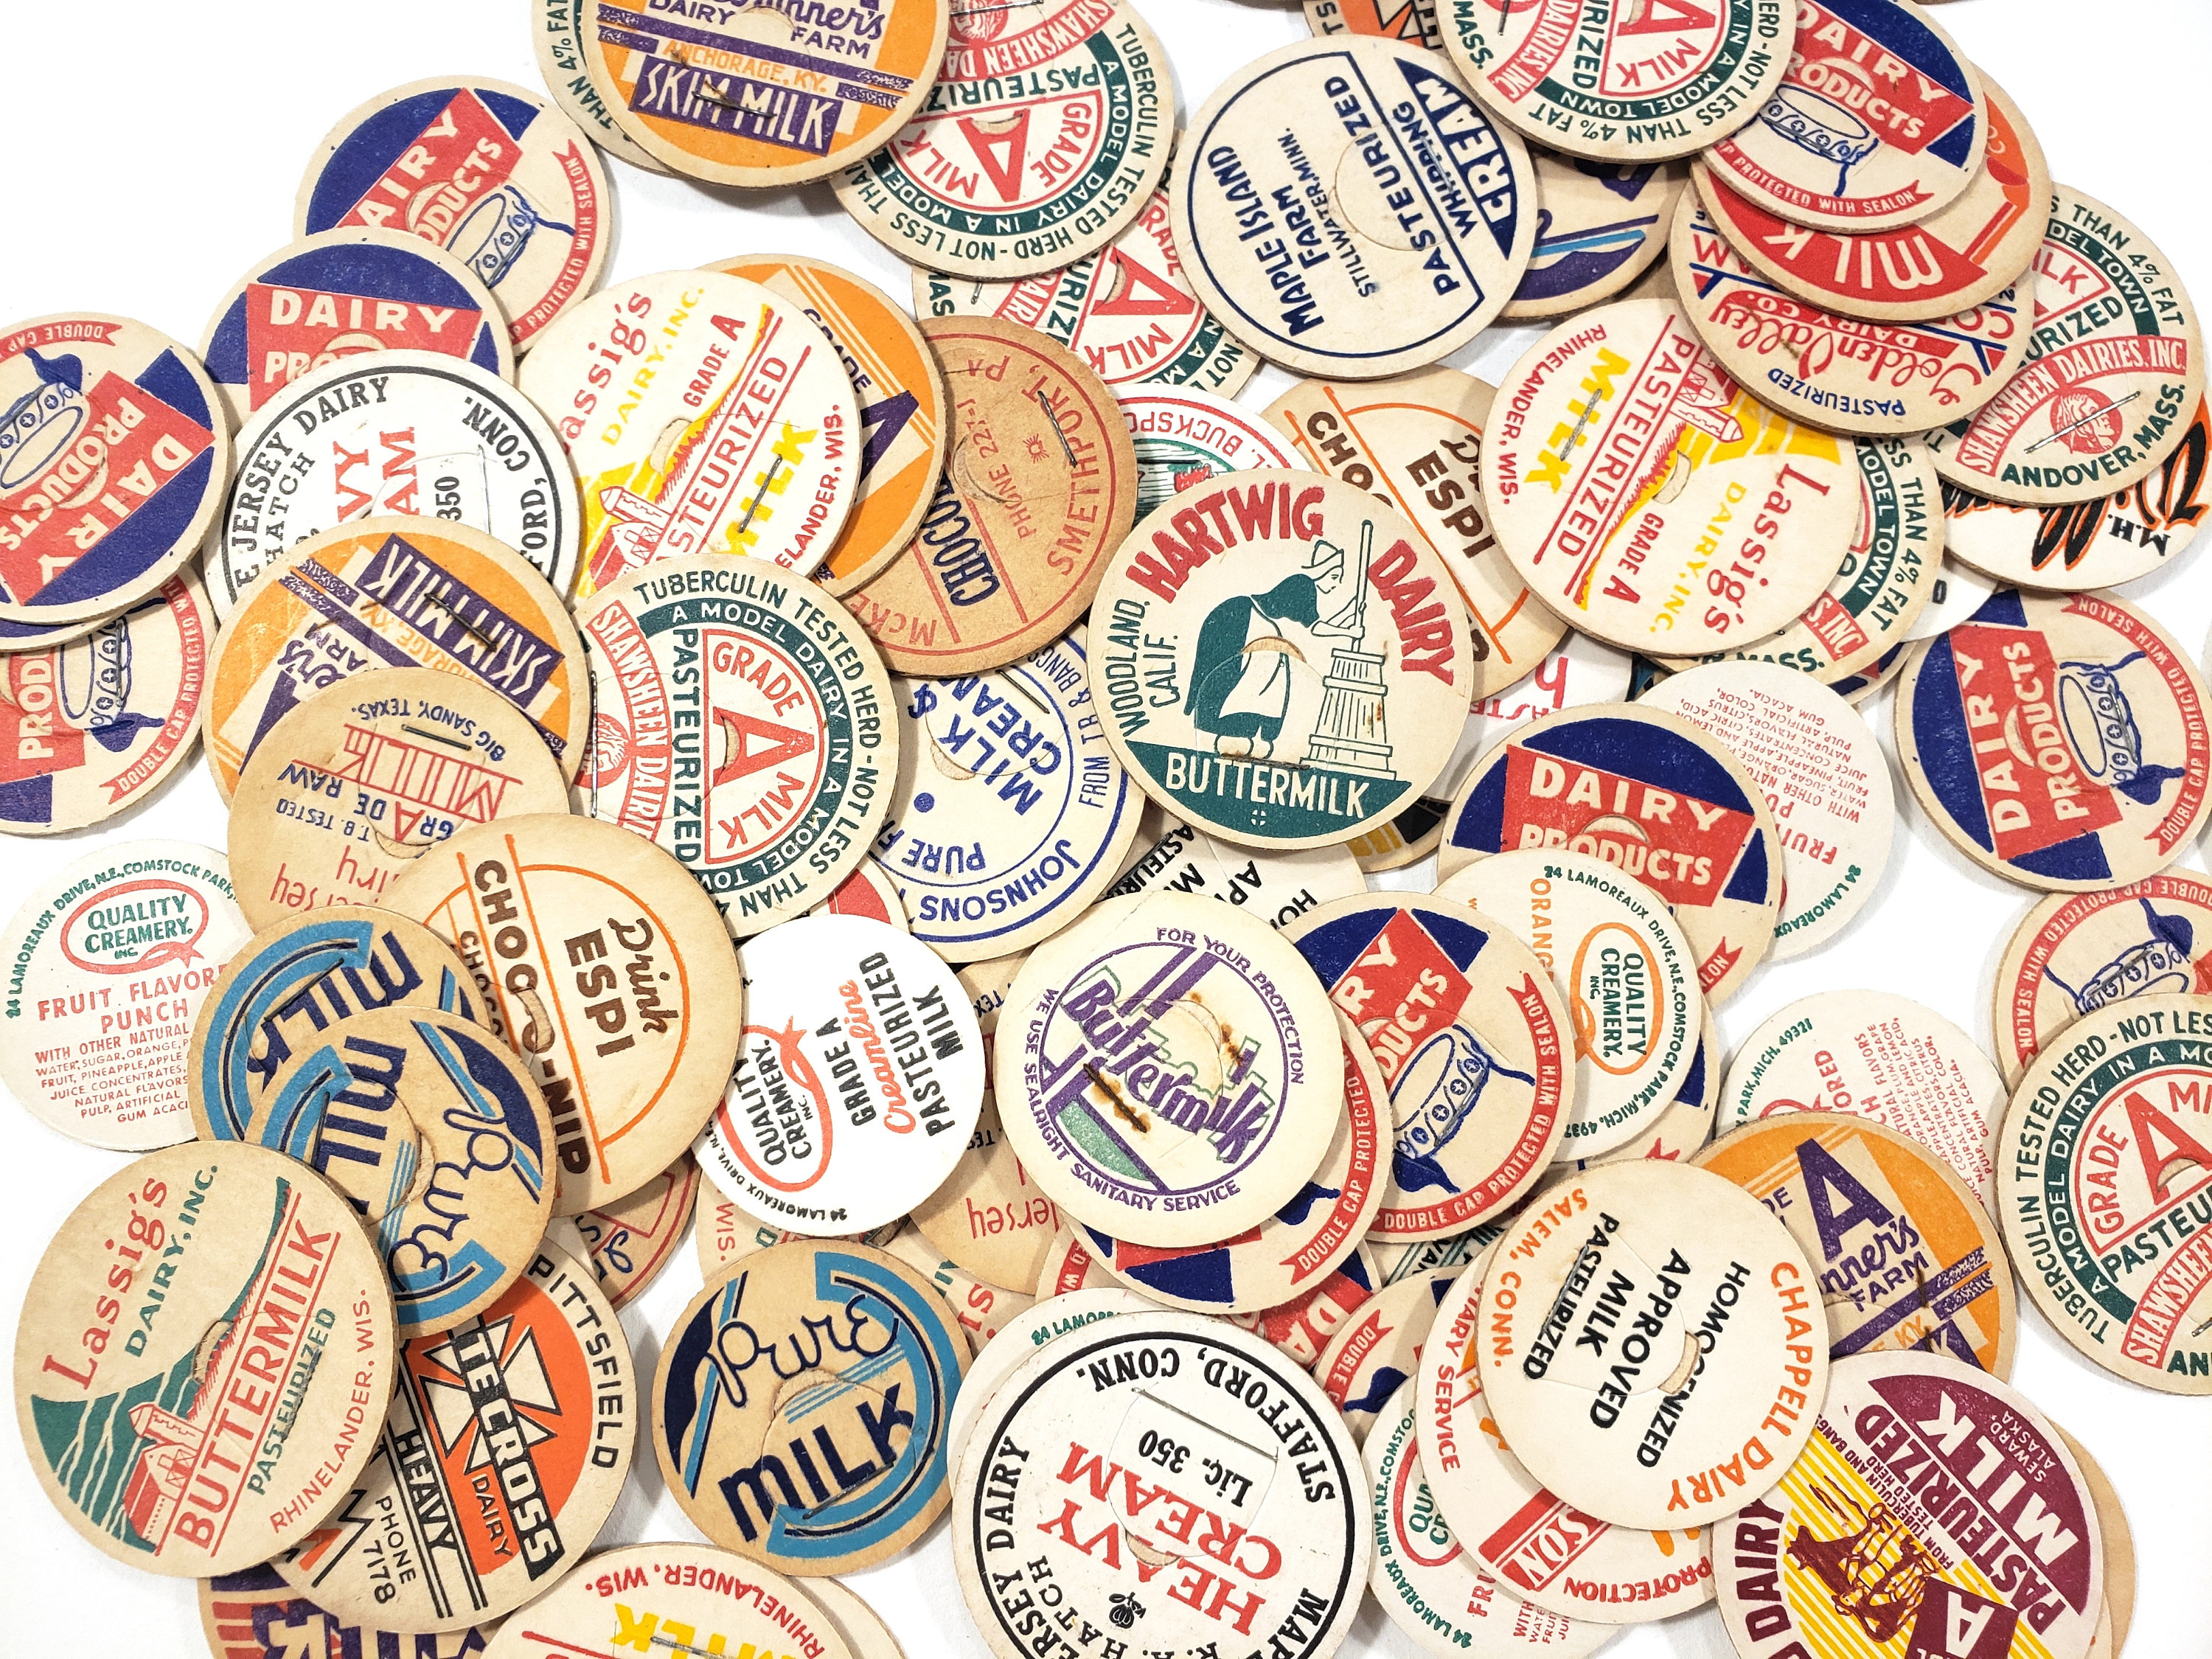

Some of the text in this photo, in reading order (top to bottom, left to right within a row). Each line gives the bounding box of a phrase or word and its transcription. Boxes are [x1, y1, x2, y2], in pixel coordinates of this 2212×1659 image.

[557, 37, 577, 70] 4%
[790, 27, 872, 59] FARM
[1616, 37, 1701, 87] MILK
[639, 60, 732, 125] SKIM
[736, 83, 834, 150] MILK
[1030, 102, 1093, 189] GRADE
[1077, 24, 1158, 237] TUBERCULIN TESTED
[1528, 89, 1747, 144] LESS THAN 4% FAT
[1560, 72, 1719, 119] MODEL TOWN
[900, 130, 981, 200] MILK
[1035, 86, 1127, 226] MODEL DAIRY
[1324, 76, 1461, 296] PASTEURIZED
[1392, 100, 1477, 239] WHIPPING
[1413, 77, 1513, 223] CREAM
[890, 211, 946, 253] LESS
[1207, 145, 1325, 336] MAPLE ISLAND
[1271, 184, 1330, 270] FARM
[1819, 196, 1856, 213] WITH
[269, 289, 456, 333] DAIRY
[2073, 203, 2184, 326] THAN 4% FAT
[45, 324, 104, 343] DOUBLE
[683, 344, 730, 408] GRADE
[1500, 324, 1607, 447] RHINELANDER,
[462, 397, 532, 473] CONN.
[1524, 347, 1632, 493] MILK
[1767, 367, 1907, 417] PASTEURIZED
[232, 376, 389, 552] JERSEY DAIRY
[1557, 334, 1691, 556] PASTEURIZED
[2001, 439, 2145, 487] ANDOVER,
[37, 432, 192, 582] DAIRY
[989, 463, 1037, 540] PHONE
[1126, 481, 1325, 603] HARTWIG
[1407, 451, 1496, 558] ESPI
[1618, 513, 1663, 575] GRADE
[1704, 463, 1830, 634] Lassig's
[1899, 478, 1927, 582] THAN 4%
[633, 570, 864, 681] TUBERCULIN TESTED
[701, 603, 848, 720] MODEL DAIRY
[1367, 540, 1455, 687] DAIRY
[116, 616, 202, 792] DOUBLE PROTECTED
[594, 604, 667, 747] SHAWSHEEN
[713, 641, 805, 717] GRADE
[1107, 600, 1150, 737] WOODLAND,
[1144, 634, 1182, 709] CALIF.
[1749, 689, 1825, 726] GUM ACACIA.
[278, 764, 343, 798] RAW
[476, 731, 507, 761] BIG
[672, 629, 703, 863] PASTEURIZED
[937, 714, 1043, 815] MILK
[1079, 756, 1110, 809] FROM
[1955, 651, 2031, 833] DAIRY
[2002, 641, 2090, 821] PRODUCTS
[2135, 631, 2205, 843] WITH PROTECTED DOUBLE
[717, 771, 805, 849] MILK
[1165, 753, 1369, 820] BUTTERMILK
[1529, 758, 1728, 834] DAIRY
[740, 816, 860, 917] LESS THAN
[902, 838, 987, 874] PURE
[920, 839, 1081, 922] JOHNSONS
[1568, 869, 1649, 919] LAMOREAUX
[84, 917, 193, 953] CREAMERY.
[88, 894, 187, 931] QUALITY
[38, 988, 111, 1020] FRUIT
[100, 998, 189, 1034] PUNCH
[565, 928, 636, 1057] ESPI
[608, 917, 679, 1034] Drink
[913, 985, 964, 1061] MILK
[1157, 927, 1304, 1085] FOR YOUR PROTECTION
[1600, 947, 1624, 1059] CREAMERY.
[1623, 953, 1648, 1055] QUALITY
[35, 1023, 190, 1064] WITH OTHER NATURAL
[91, 1064, 187, 1091] CONCENTRATES,
[824, 1040, 877, 1127] GRADE
[838, 979, 916, 1134] Creamline
[859, 951, 956, 1137] PASTEURIZED
[1062, 979, 1268, 1165] Buttermilk
[1854, 1033, 1887, 1086] FLAVORS
[116, 1091, 181, 1111] ARTIFICIAL
[117, 1110, 147, 1123] GUM
[751, 1039, 812, 1160] CREAMERY.
[1024, 1020, 1241, 1212] USE SEALRIGHT SANITARY SERVICE
[1346, 1076, 1378, 1171] PROTECTED
[1383, 992, 1560, 1229] DOUBLE PROTECTED WITH SEALON
[2016, 1085, 2110, 1345] TUBERCULIN TESTED
[2049, 1080, 2099, 1270] MODEL DAIRY
[2088, 1124, 2129, 1237] GRADE
[42, 1178, 167, 1390] Lassig's
[1490, 1188, 1589, 1367] SALEM, CONN.
[1522, 1211, 1620, 1381] PASTEURIZED
[1574, 1269, 1635, 1358] MILK
[1851, 1251, 1930, 1313] FARM
[174, 1219, 331, 1550] BUTTERMILK
[526, 1254, 624, 1470] PITTSFIELD
[1590, 1247, 1693, 1430] APPROVED
[1666, 1262, 1813, 1512] CHAPPELL DAIRY
[247, 1307, 337, 1495] PASTEURIZED
[269, 1288, 375, 1534] RHINELANDER, WIS.
[1077, 1346, 1336, 1503] STAFFORD, CONN.
[1138, 1429, 1191, 1475] 350
[1434, 1365, 1461, 1473] SERVICE
[1989, 1413, 2047, 1482] SEWARD,
[2002, 1410, 2055, 1470] ALASKA
[395, 1433, 458, 1554] HEAVY
[470, 1472, 514, 1557] DAIRY
[479, 1405, 558, 1562] CROSS
[984, 1436, 1030, 1551] DAIRY
[1056, 1441, 1282, 1580] CREAM
[1854, 1404, 2066, 1635] PASTEURIZED
[1866, 1473, 1924, 1540] TUBERCULIN
[1917, 1390, 2079, 1568] MILK
[363, 1538, 397, 1604] 7178
[375, 1495, 417, 1584] PHONE
[585, 1565, 649, 1598] WIS.
[1037, 1499, 1267, 1635] HEAVY
[1562, 1555, 1711, 1602] PROTECTION
[1735, 1498, 1792, 1641] DAIRY
